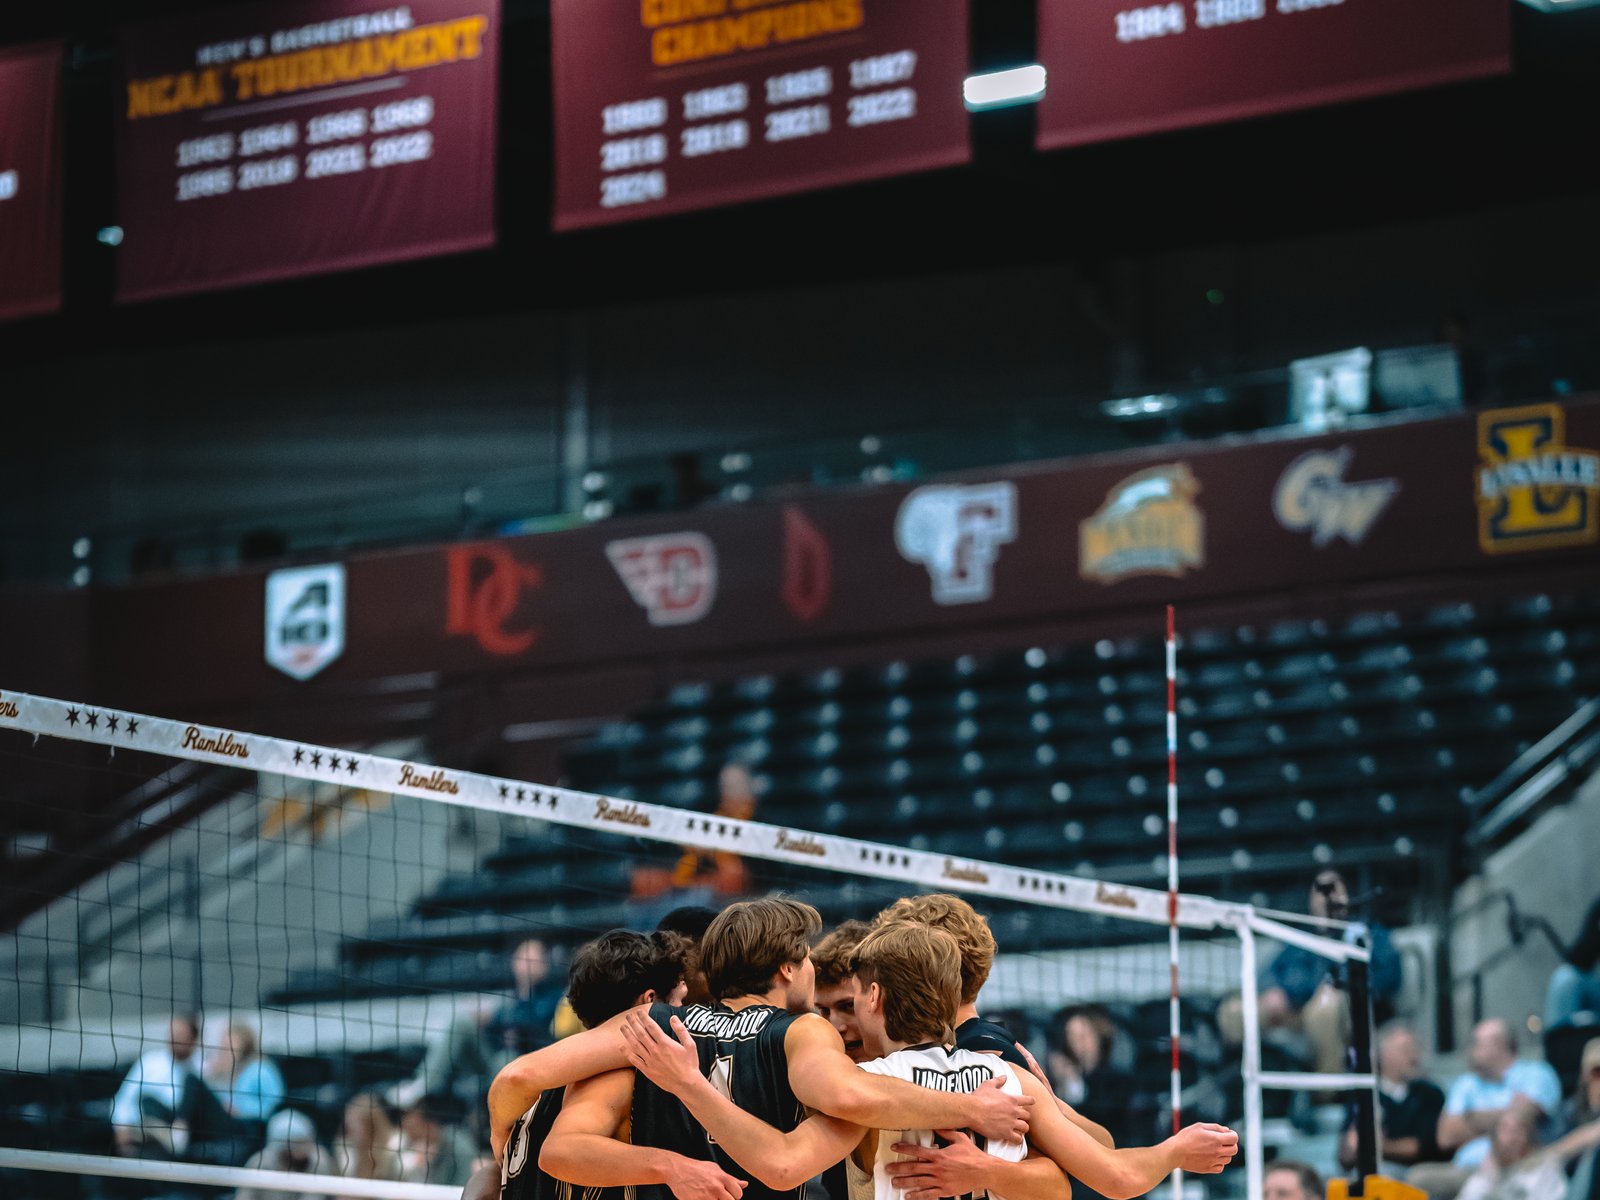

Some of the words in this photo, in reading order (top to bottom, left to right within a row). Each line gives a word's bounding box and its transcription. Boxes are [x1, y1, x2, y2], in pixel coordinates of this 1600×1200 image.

[127, 69, 222, 119] NCAA
[231, 14, 488, 99] TOURNAMENT
[182, 726, 249, 758] Ramblers
[399, 764, 459, 795] Ramblers
